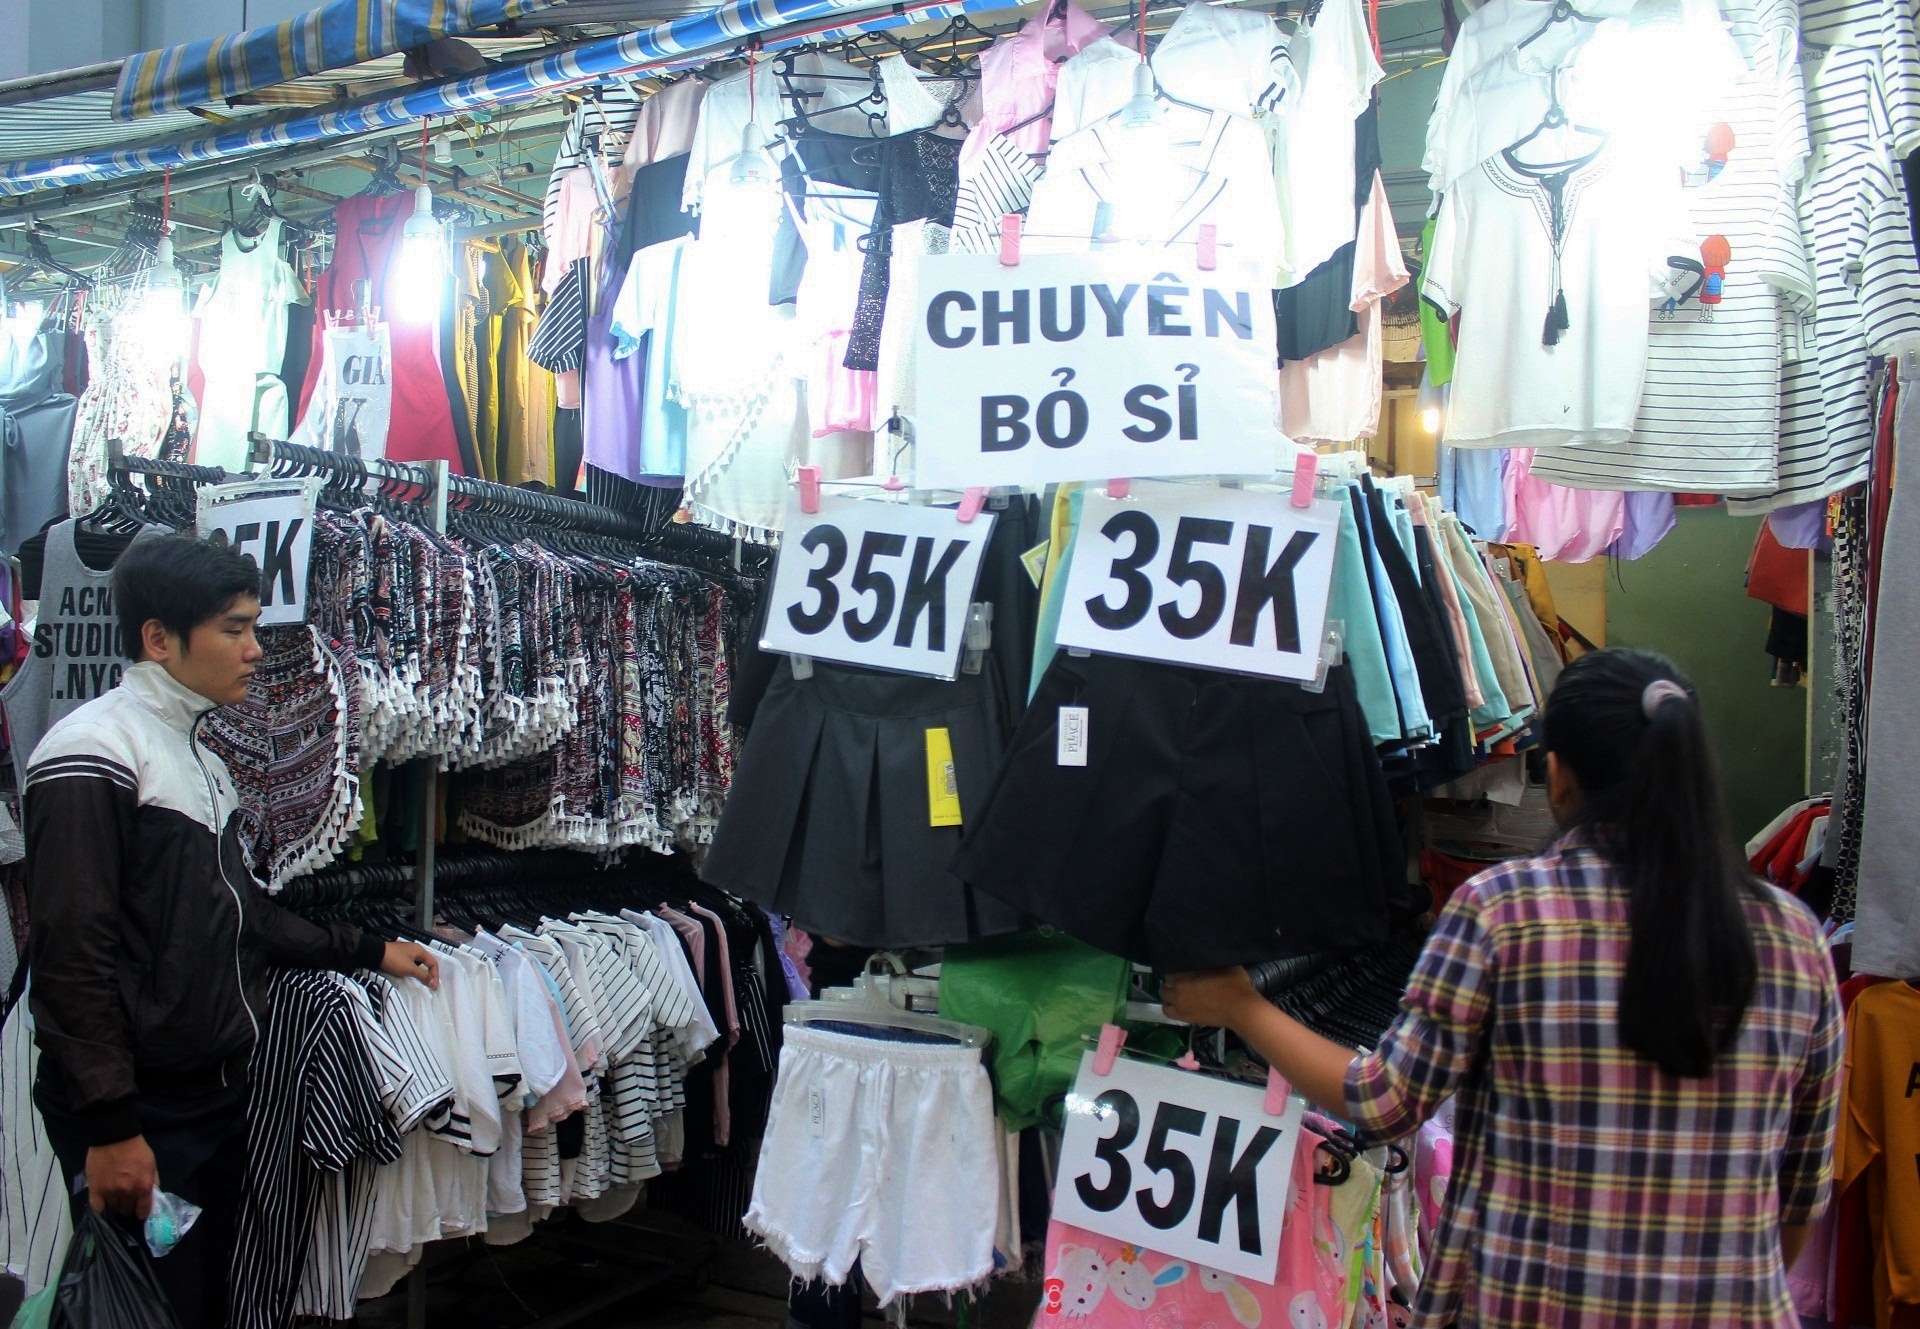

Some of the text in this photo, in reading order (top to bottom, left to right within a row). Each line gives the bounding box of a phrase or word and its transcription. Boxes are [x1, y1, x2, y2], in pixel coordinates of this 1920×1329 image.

[926, 271, 1253, 349] CHUYÊN
[981, 362, 1200, 453] BỎ SỈ
[786, 523, 971, 653] 35K
[1084, 509, 1321, 655] 35K
[1074, 1088, 1283, 1257] 35K
